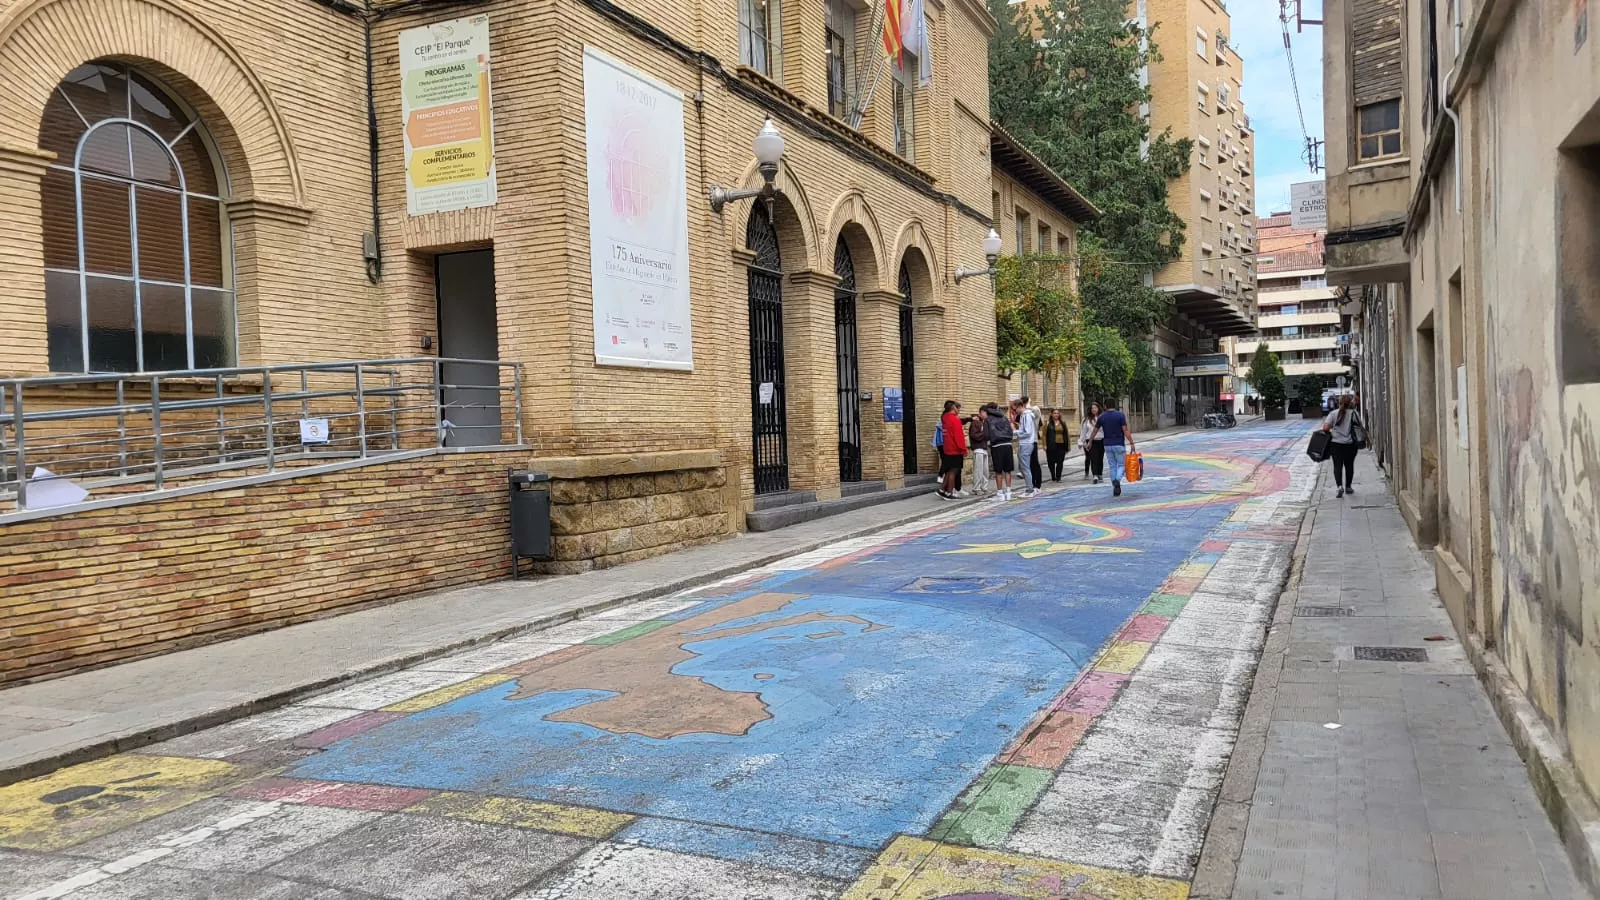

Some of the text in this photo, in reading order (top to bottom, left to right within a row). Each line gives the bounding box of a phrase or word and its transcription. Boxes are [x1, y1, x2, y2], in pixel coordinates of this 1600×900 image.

[414, 44, 432, 56] CEIP
[424, 64, 465, 77] PROGRAMAS
[423, 152, 475, 165] COMPLEMENTARIOS
[434, 147, 462, 157] SERVICIOS
[611, 244, 672, 271] 175 Aniversario
